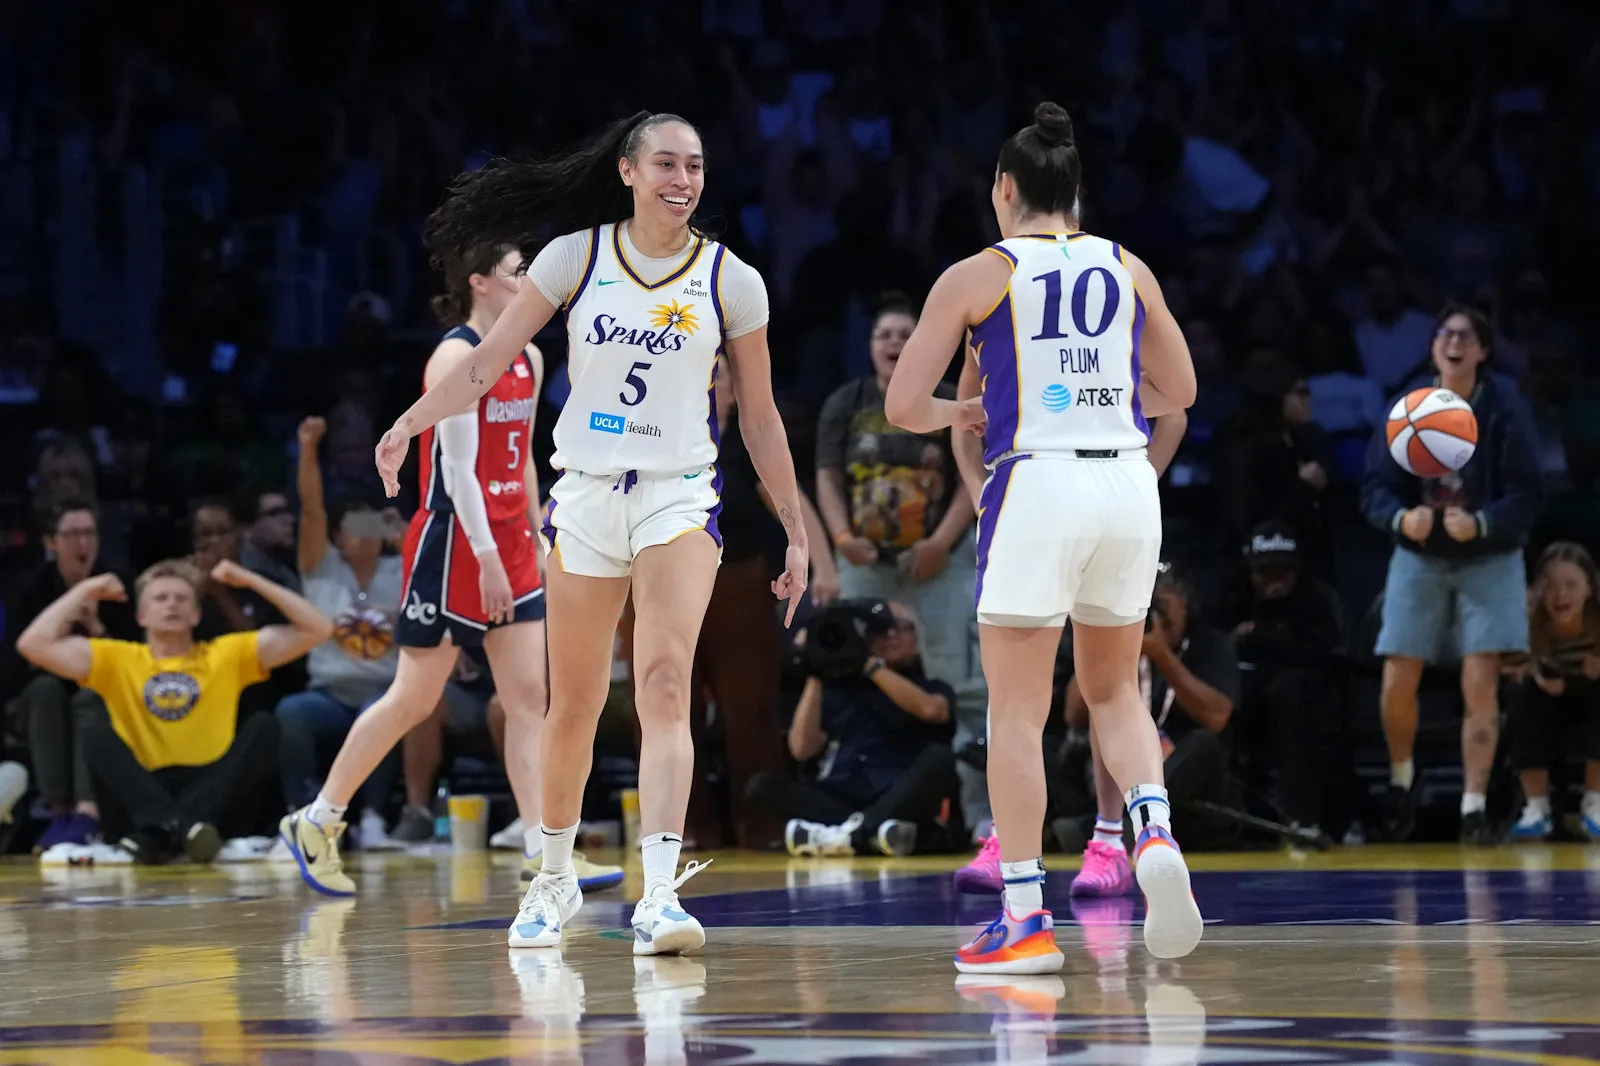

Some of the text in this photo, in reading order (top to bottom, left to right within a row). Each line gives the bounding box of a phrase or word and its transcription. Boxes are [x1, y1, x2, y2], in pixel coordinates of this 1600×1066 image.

[1031, 266, 1121, 341] 10
[1059, 348, 1100, 374] PLUM
[619, 361, 653, 407] 5
[1076, 387, 1124, 407] AT&T
[594, 416, 662, 438] UCLA Health
[507, 431, 521, 470] 5
